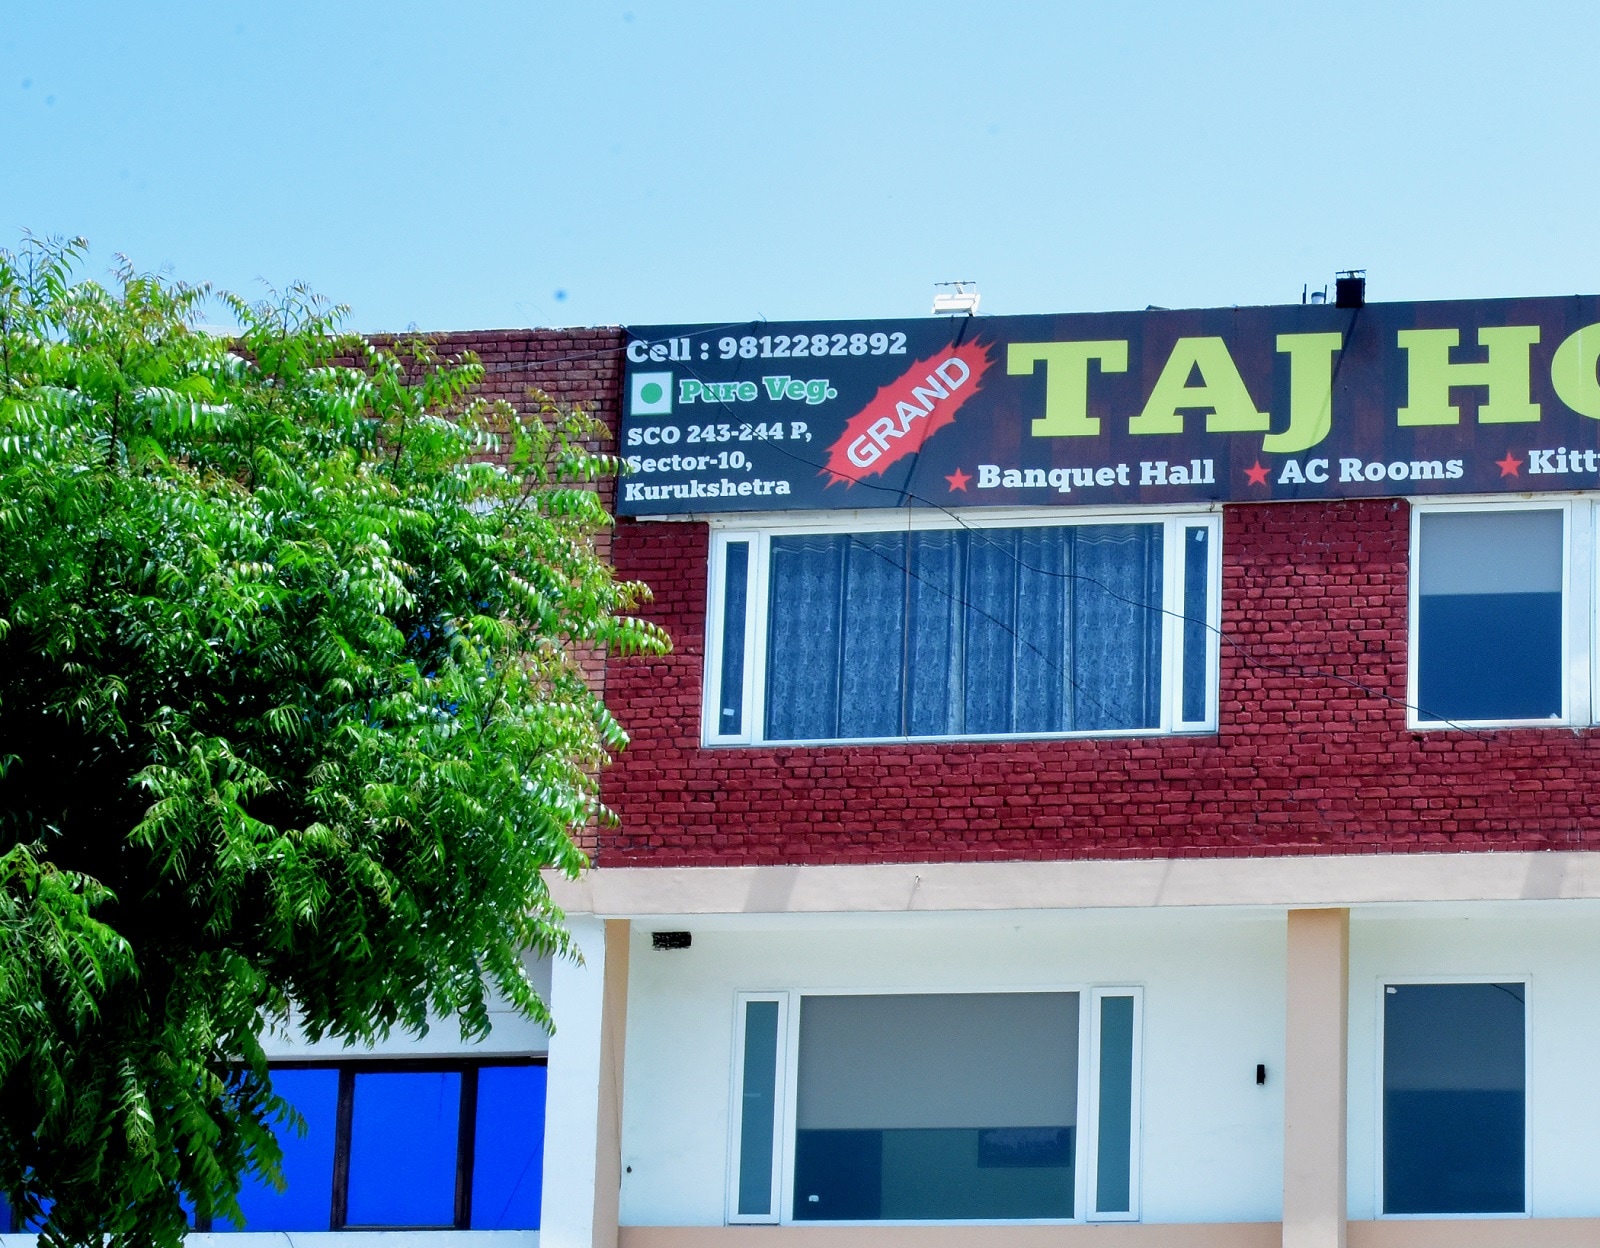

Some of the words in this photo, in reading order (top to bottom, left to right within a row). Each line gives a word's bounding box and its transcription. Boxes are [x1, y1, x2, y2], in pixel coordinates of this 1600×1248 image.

[626, 338, 692, 363] Cell
[718, 331, 907, 360] 9812282892
[678, 378, 759, 405] Pure
[761, 374, 839, 406] Veg.
[1008, 332, 1342, 453] TAJ
[846, 357, 970, 468] GRAND
[627, 425, 681, 446] SCO
[686, 422, 784, 443] 243-244
[790, 421, 812, 443] P,
[627, 450, 753, 474] Sector-10,
[976, 463, 1130, 493] Banquet
[1139, 458, 1216, 486] Hall
[1277, 458, 1330, 484] AC
[1338, 457, 1464, 483] Rooms
[624, 478, 791, 502] Kurukshetra
